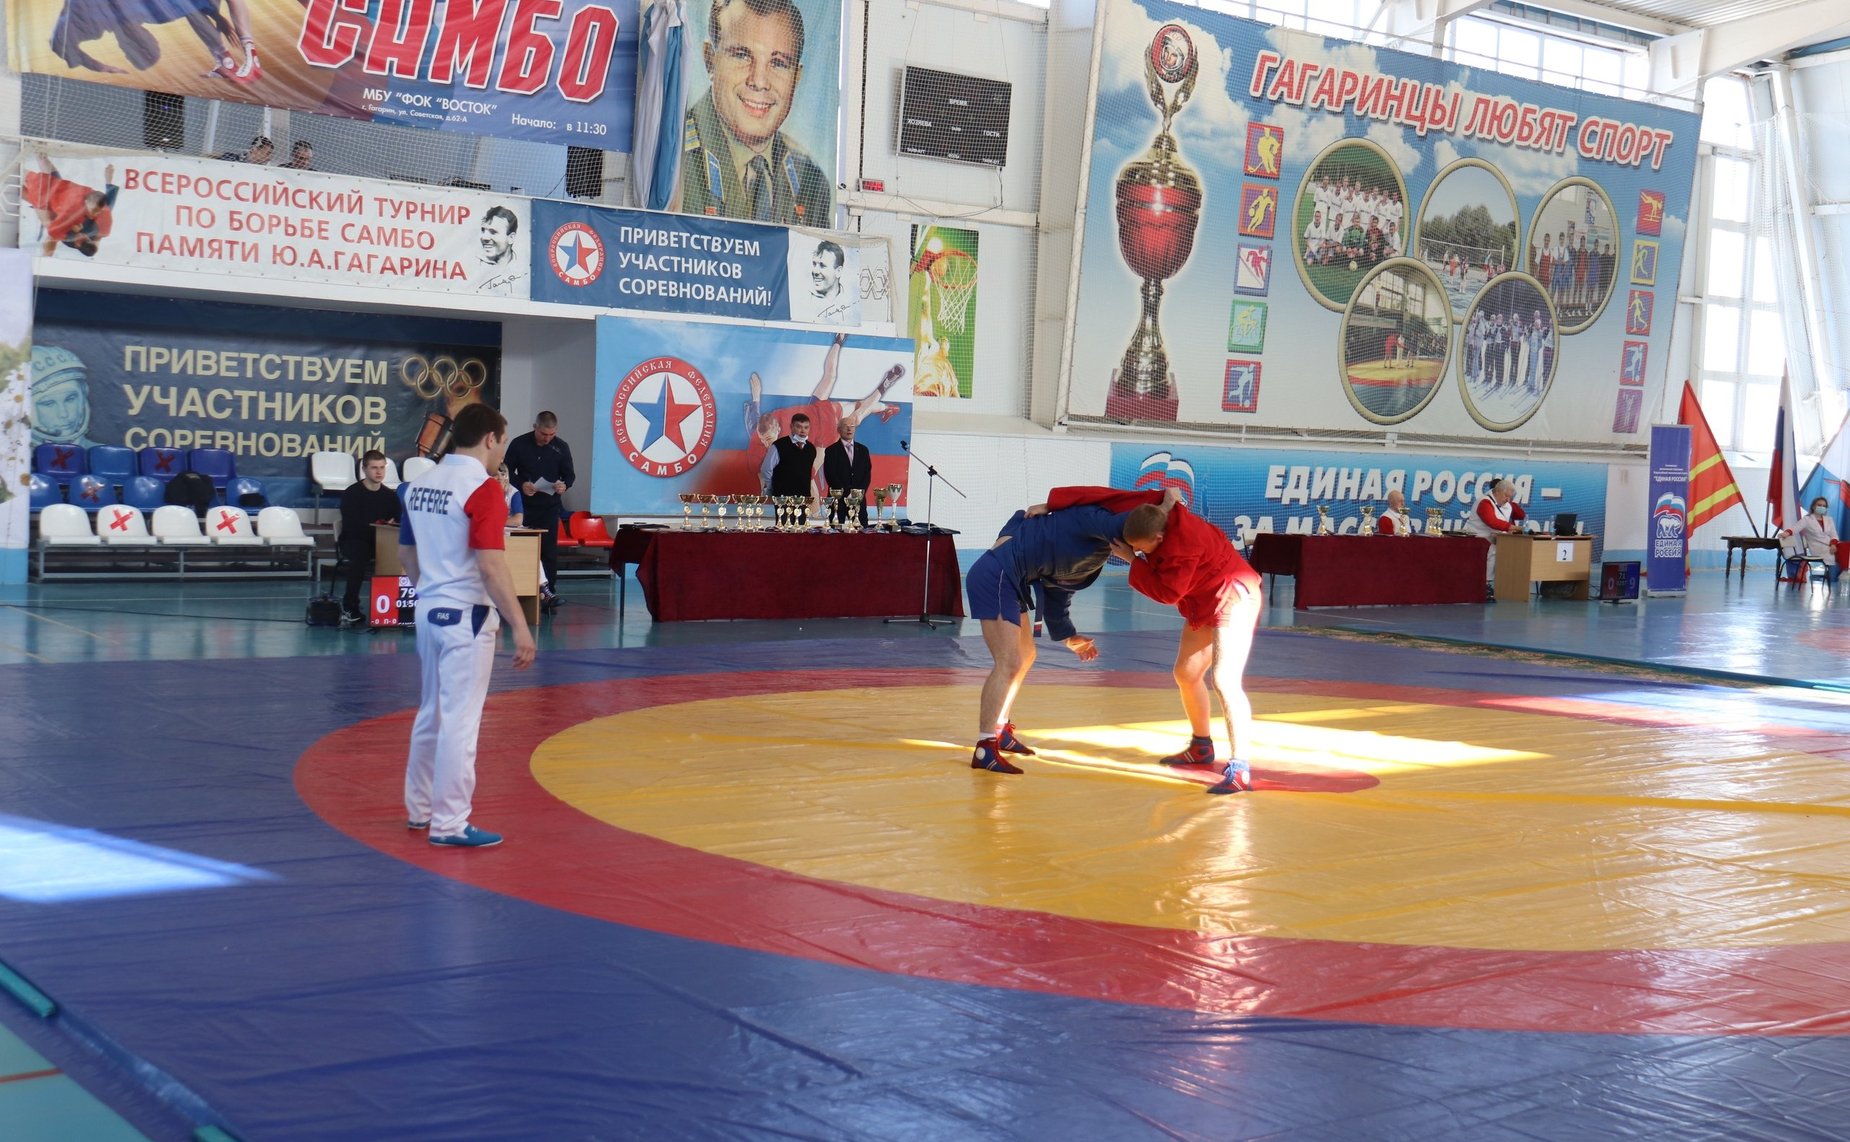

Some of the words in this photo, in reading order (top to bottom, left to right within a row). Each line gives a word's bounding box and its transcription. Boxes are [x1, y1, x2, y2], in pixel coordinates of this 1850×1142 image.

[298, 0, 620, 103] САМБО
[363, 88, 391, 102] МБУ
[368, 104, 397, 114] Гагарин,
[410, 110, 445, 121] Советская,
[511, 113, 556, 130] Начало:
[566, 122, 573, 131] в
[576, 121, 607, 136] 11:30
[1250, 50, 1458, 137] ГАГАРИНЦЫ
[1463, 97, 1577, 153] ЛЮБЯТ
[1577, 118, 1674, 170] СПОРТ
[124, 168, 364, 216] ВСЕРОССИЙСКИЙ
[374, 196, 471, 226] ТУРНИР
[175, 205, 216, 230] ПО
[229, 210, 331, 241] БОРЬБЕ
[340, 222, 435, 252] САМБО
[620, 226, 760, 257] ПРИВЕТСТВУЕМ
[136, 231, 258, 262] ПАМЯТИ
[271, 243, 468, 282] Ю.А.ГАГАРИНА
[619, 252, 742, 279] УЧАСТНИКОВ
[558, 272, 596, 286] САМБО
[619, 277, 772, 307] СОРЕВНОВАНИЙ!
[124, 346, 388, 385] ПРИВЕТСТВУЕМ
[123, 385, 387, 426] УЧАСТНИКОВ
[615, 360, 672, 445] ВСЕРОССИЙСКАЯ
[124, 426, 386, 459] СОРЕВНОВАНИЙ
[629, 452, 697, 476] САМБО
[1264, 465, 1406, 505] ЕДИНАЯ
[408, 487, 453, 515] REFEREE
[1655, 539, 1682, 548] ЕДИНАЯ
[1655, 548, 1682, 558] РОССИЯ
[376, 595, 390, 614] 0
[401, 587, 416, 598] 79
[437, 612, 450, 620] FIAS
